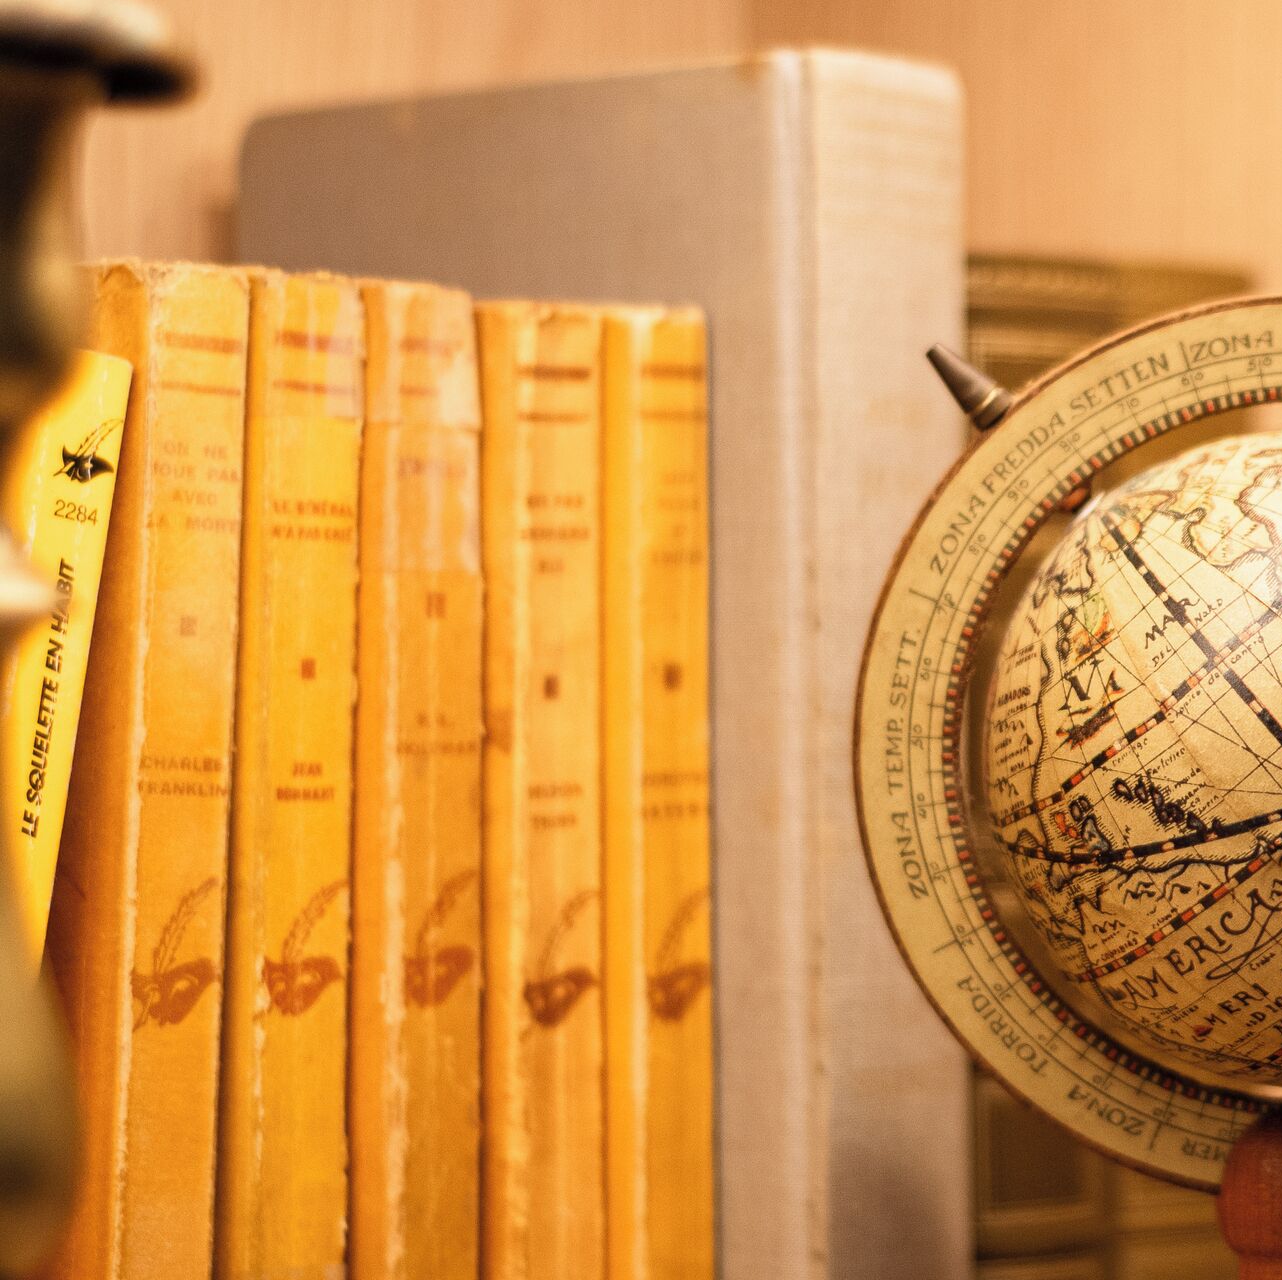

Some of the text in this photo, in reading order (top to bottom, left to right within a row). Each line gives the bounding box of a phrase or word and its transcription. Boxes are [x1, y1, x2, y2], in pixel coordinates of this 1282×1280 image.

[1187, 327, 1275, 364] ZONA
[924, 350, 1172, 577] ZONA FREDDA SETTEN
[53, 498, 99, 526] 2284
[45, 638, 65, 674] EN
[25, 674, 60, 806] SQUELETTE
[882, 623, 933, 902] ZONA TEMP. SETT.
[21, 809, 40, 840] LE
[1204, 981, 1271, 1028] MERI
[951, 972, 1148, 1139] ZONA TORRIDA
